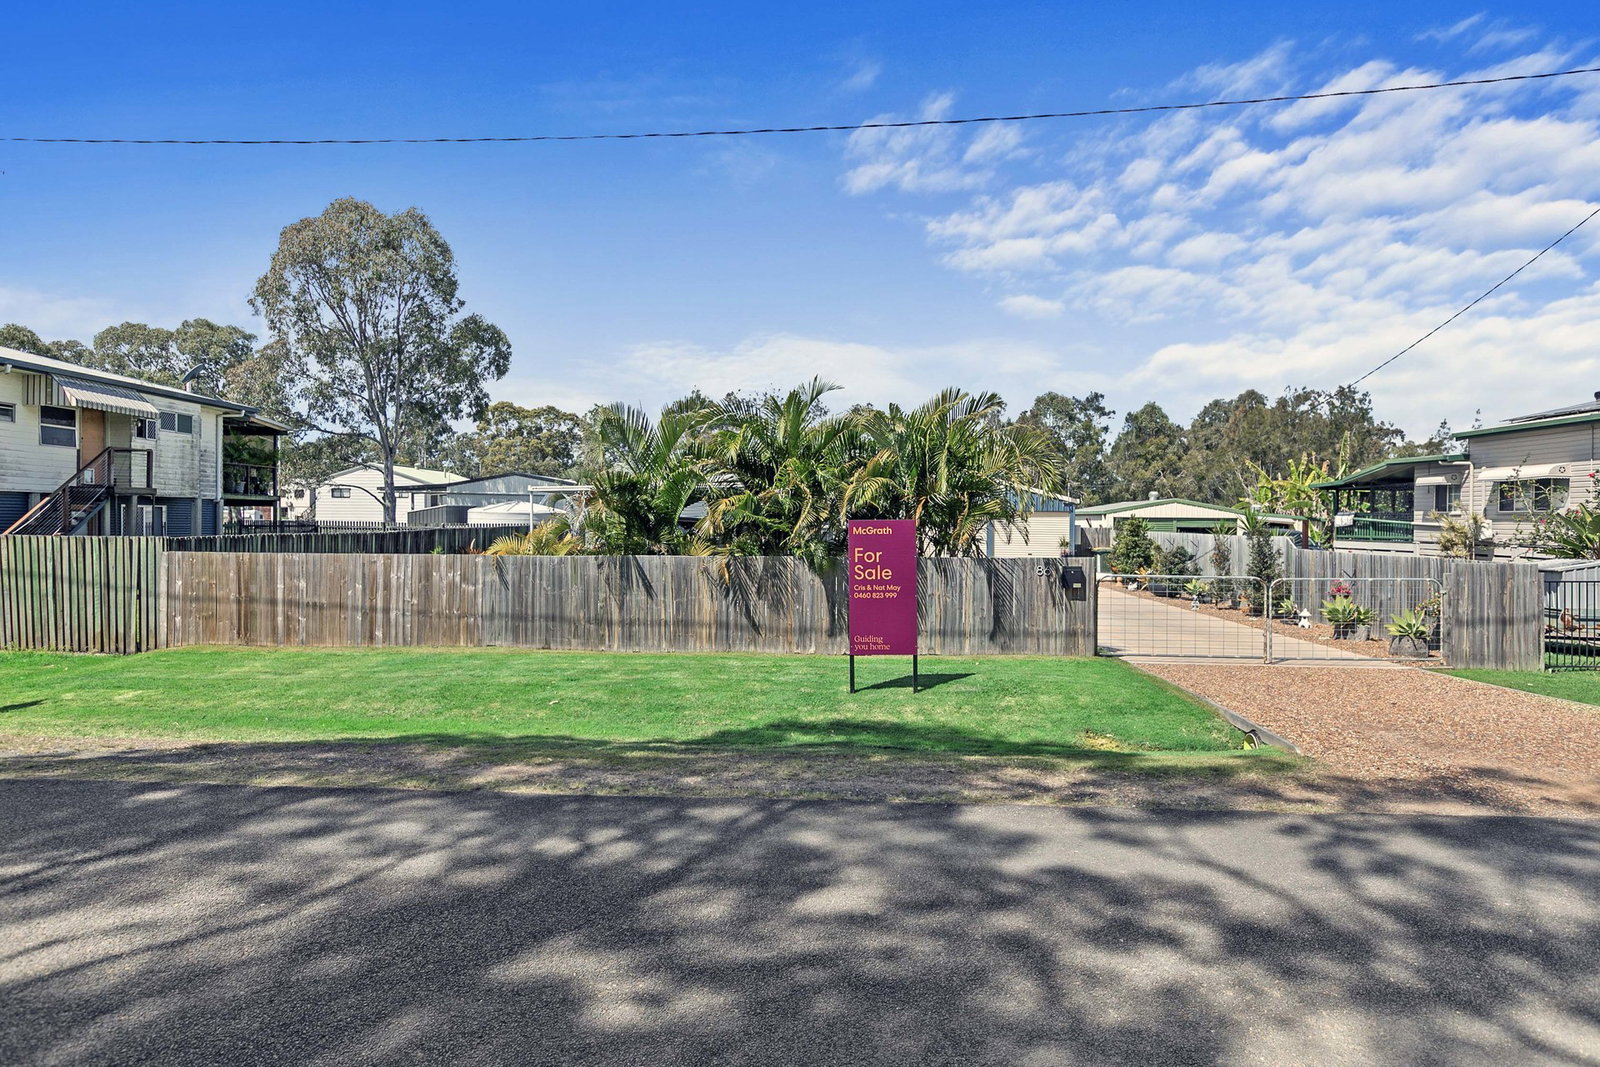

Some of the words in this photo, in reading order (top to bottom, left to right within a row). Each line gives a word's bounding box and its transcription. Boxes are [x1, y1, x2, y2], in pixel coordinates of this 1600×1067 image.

[853, 526, 892, 535] McGrath
[854, 548, 882, 562] For
[854, 565, 892, 580] Sale
[854, 635, 884, 644] Guiding
